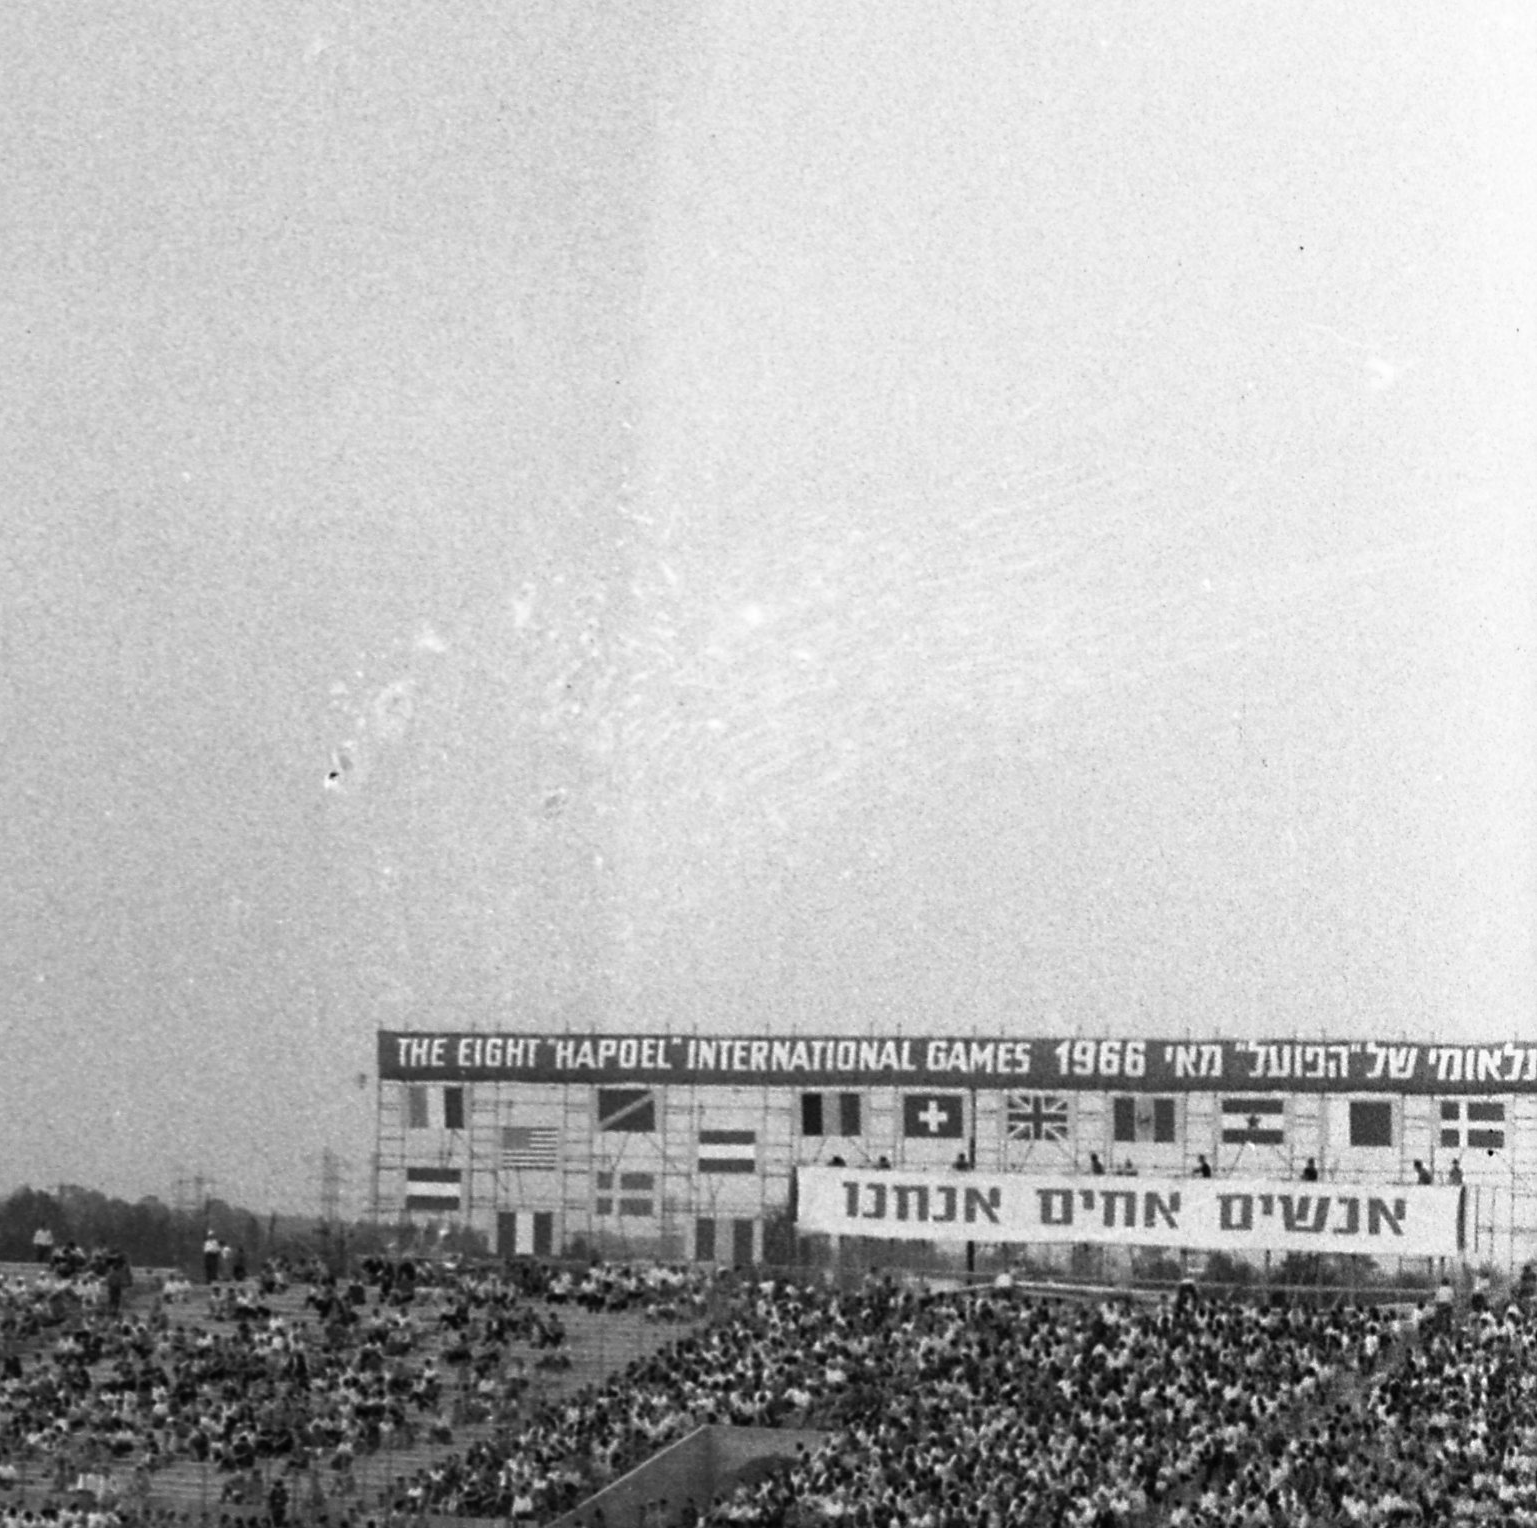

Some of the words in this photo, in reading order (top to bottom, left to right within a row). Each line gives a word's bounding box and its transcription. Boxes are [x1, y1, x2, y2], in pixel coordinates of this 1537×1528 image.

[397, 1037, 447, 1067] THE
[458, 1037, 540, 1068] EIGHT
[686, 1039, 916, 1072] INTERNATIONAL
[927, 1041, 1031, 1073] GAMES
[1054, 1041, 1147, 1077] 1966
[1164, 1042, 1223, 1077] מאי
[1366, 1041, 1418, 1080] של
[842, 1181, 1002, 1224] אנחנו
[1035, 1188, 1181, 1229] אחים
[1216, 1193, 1407, 1236] אנשים
